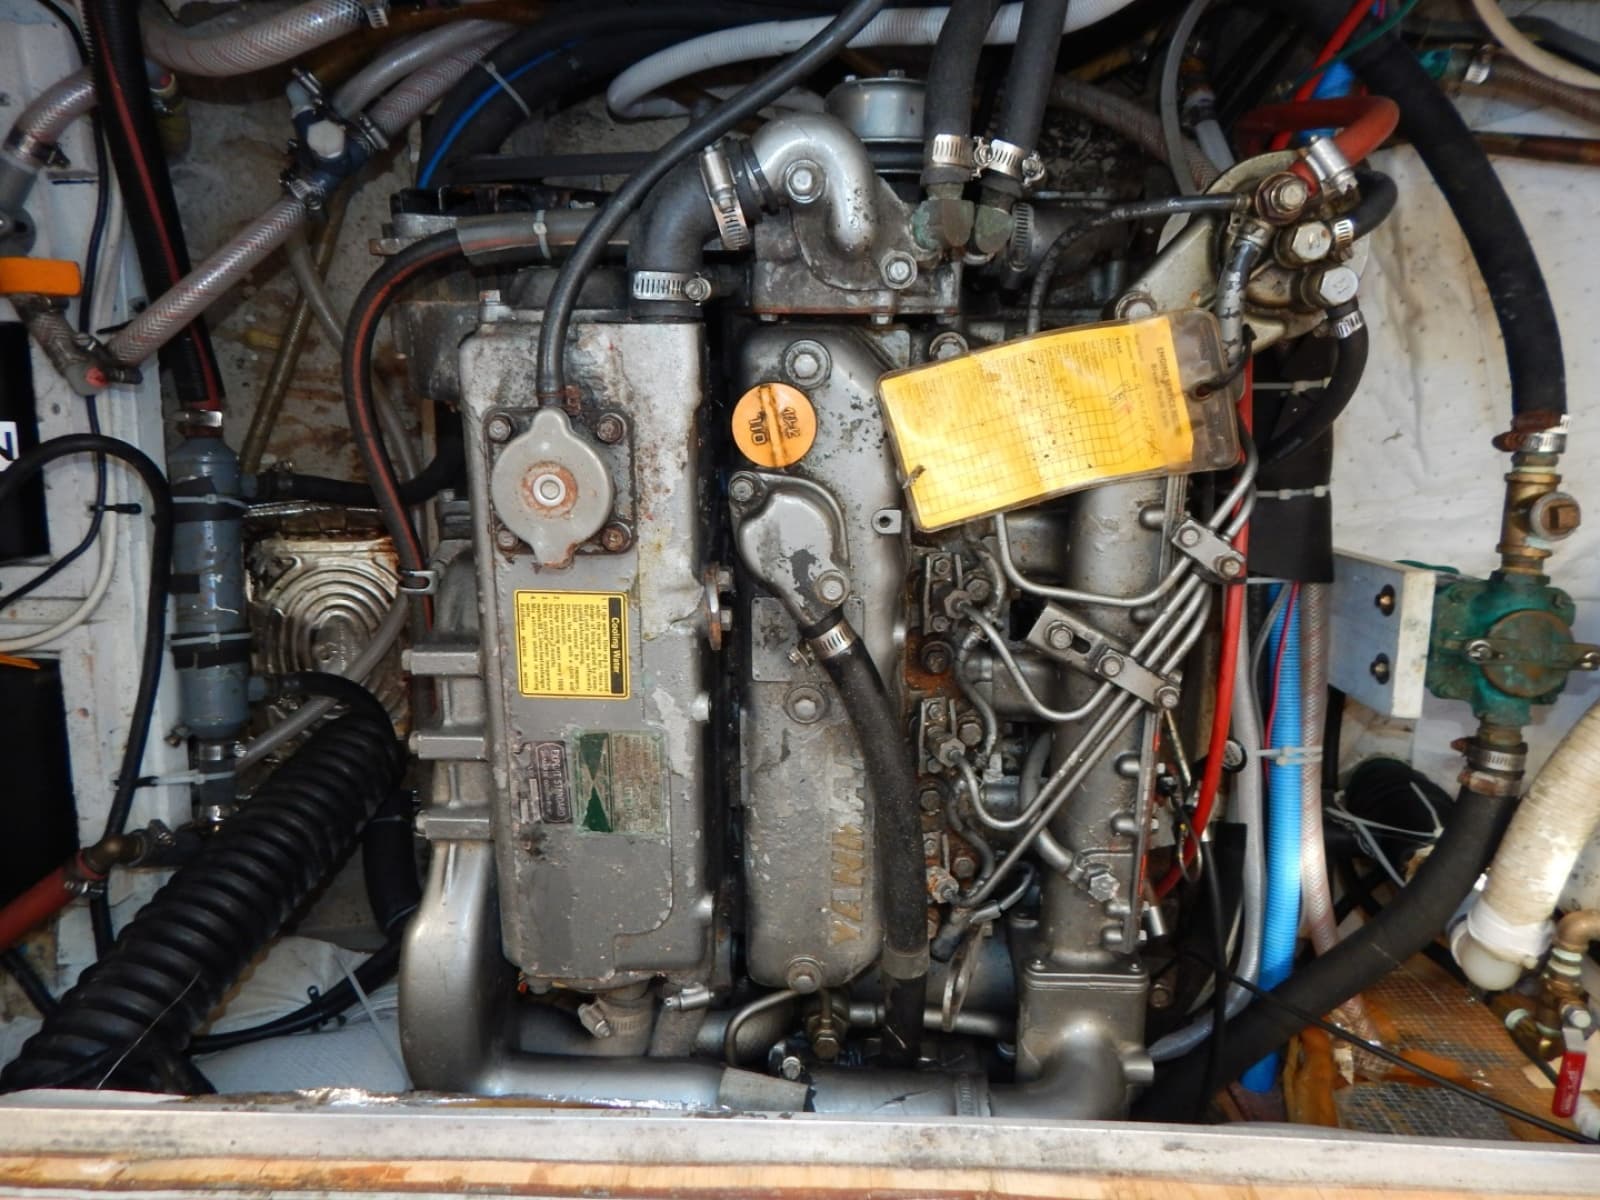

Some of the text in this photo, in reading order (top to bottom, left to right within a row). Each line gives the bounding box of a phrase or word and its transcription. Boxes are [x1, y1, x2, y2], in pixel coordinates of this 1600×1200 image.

[748, 410, 768, 445] OIL
[611, 618, 620, 648] Cooling
[553, 779, 567, 817] STANDARD
